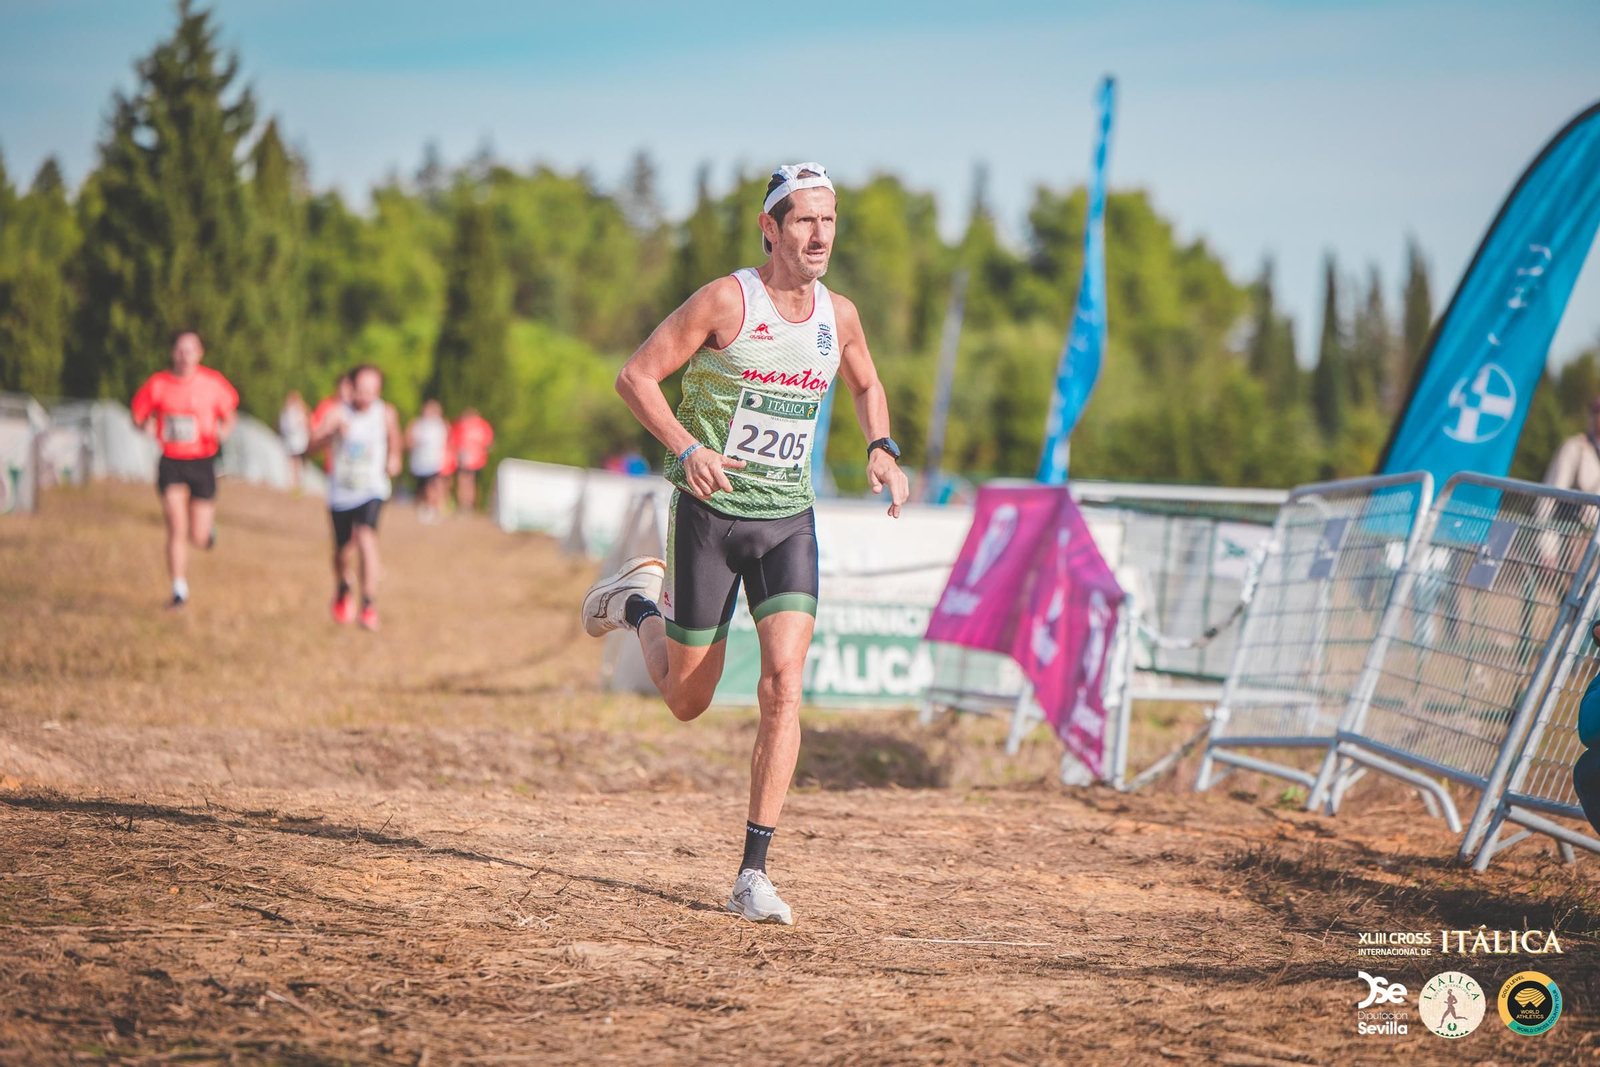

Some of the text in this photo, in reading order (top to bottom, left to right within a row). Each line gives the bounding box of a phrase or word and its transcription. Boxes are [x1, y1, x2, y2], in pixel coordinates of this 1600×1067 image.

[742, 368, 828, 391] maratón
[768, 400, 805, 414] ITÁLICA
[736, 424, 808, 461] 2205
[804, 633, 934, 695] TÁLICA
